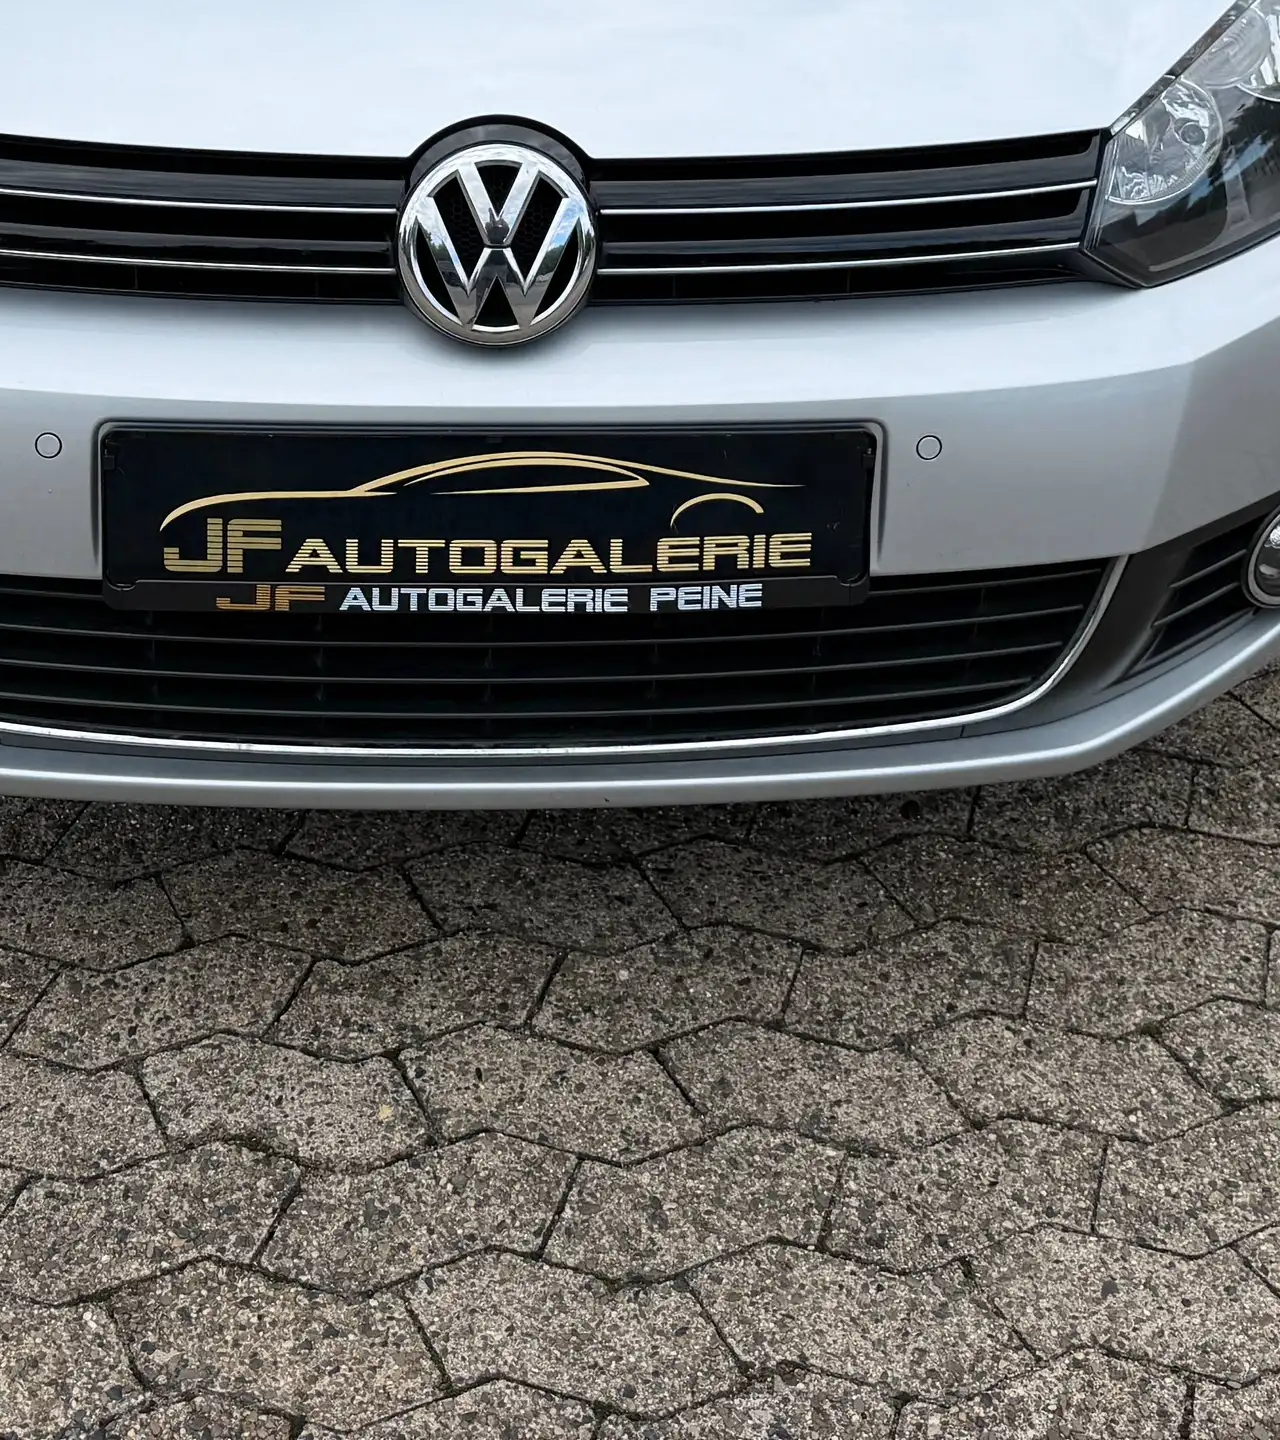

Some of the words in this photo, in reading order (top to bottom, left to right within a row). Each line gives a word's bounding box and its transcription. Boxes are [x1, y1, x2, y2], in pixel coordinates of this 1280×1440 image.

[400, 145, 596, 344] VW
[164, 517, 282, 574] JF
[286, 533, 812, 574] AUTOGALERIE
[216, 584, 326, 612] JF
[339, 586, 628, 613] AUTOGALERIE
[650, 583, 764, 612] PEINE
